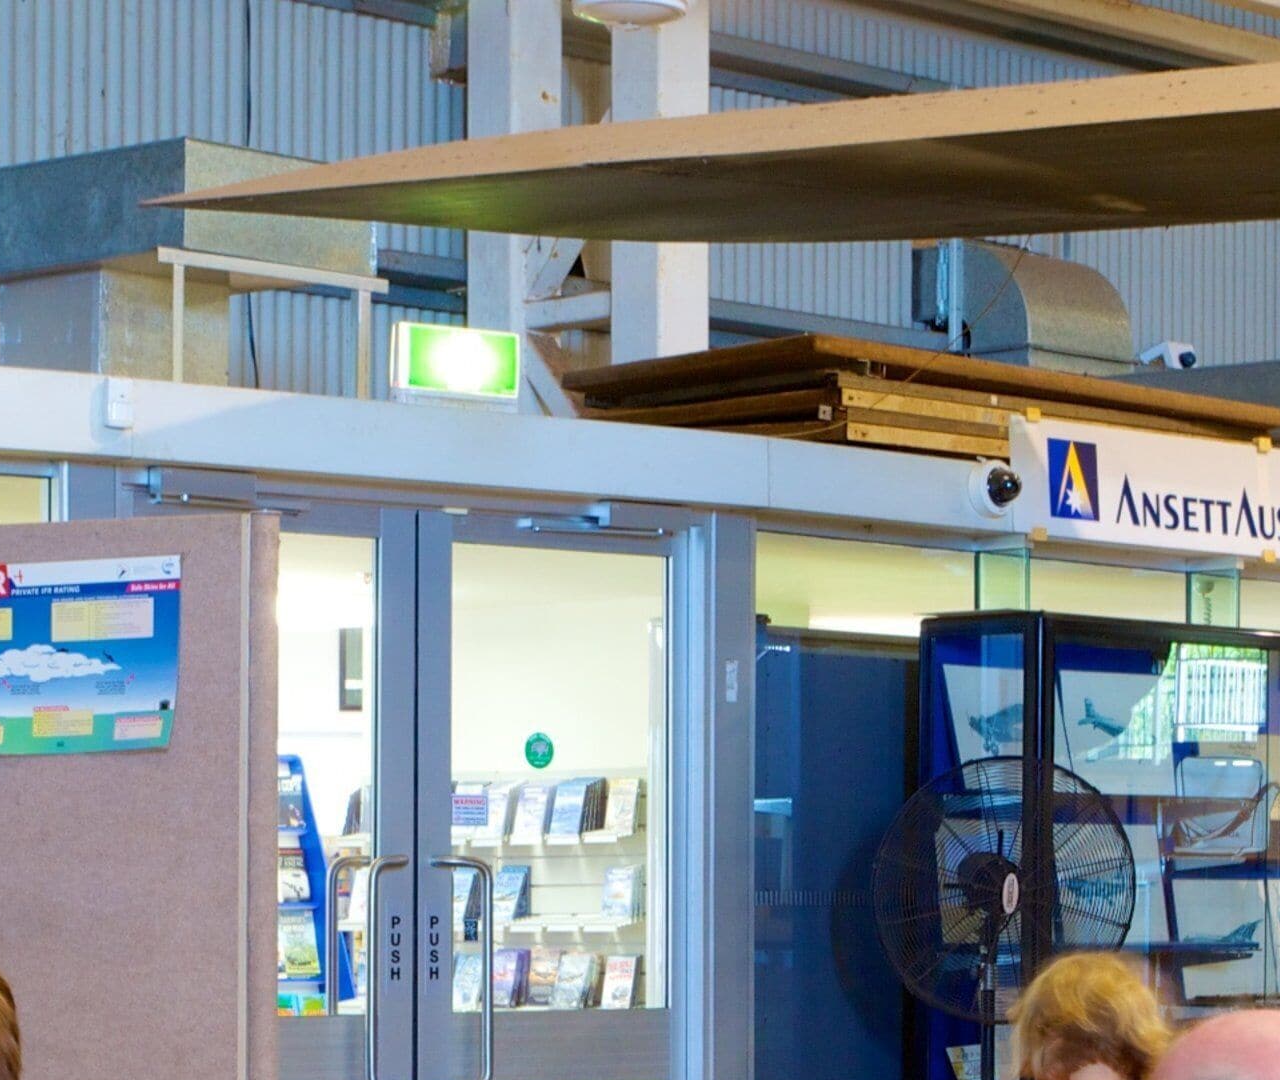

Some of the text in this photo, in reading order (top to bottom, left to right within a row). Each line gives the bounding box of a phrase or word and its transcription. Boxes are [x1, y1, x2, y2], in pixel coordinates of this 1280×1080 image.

[11, 587, 39, 596] PRIVATE
[53, 585, 80, 594] RATING
[390, 915, 401, 981] PUSH
[429, 915, 439, 980] PUSH
